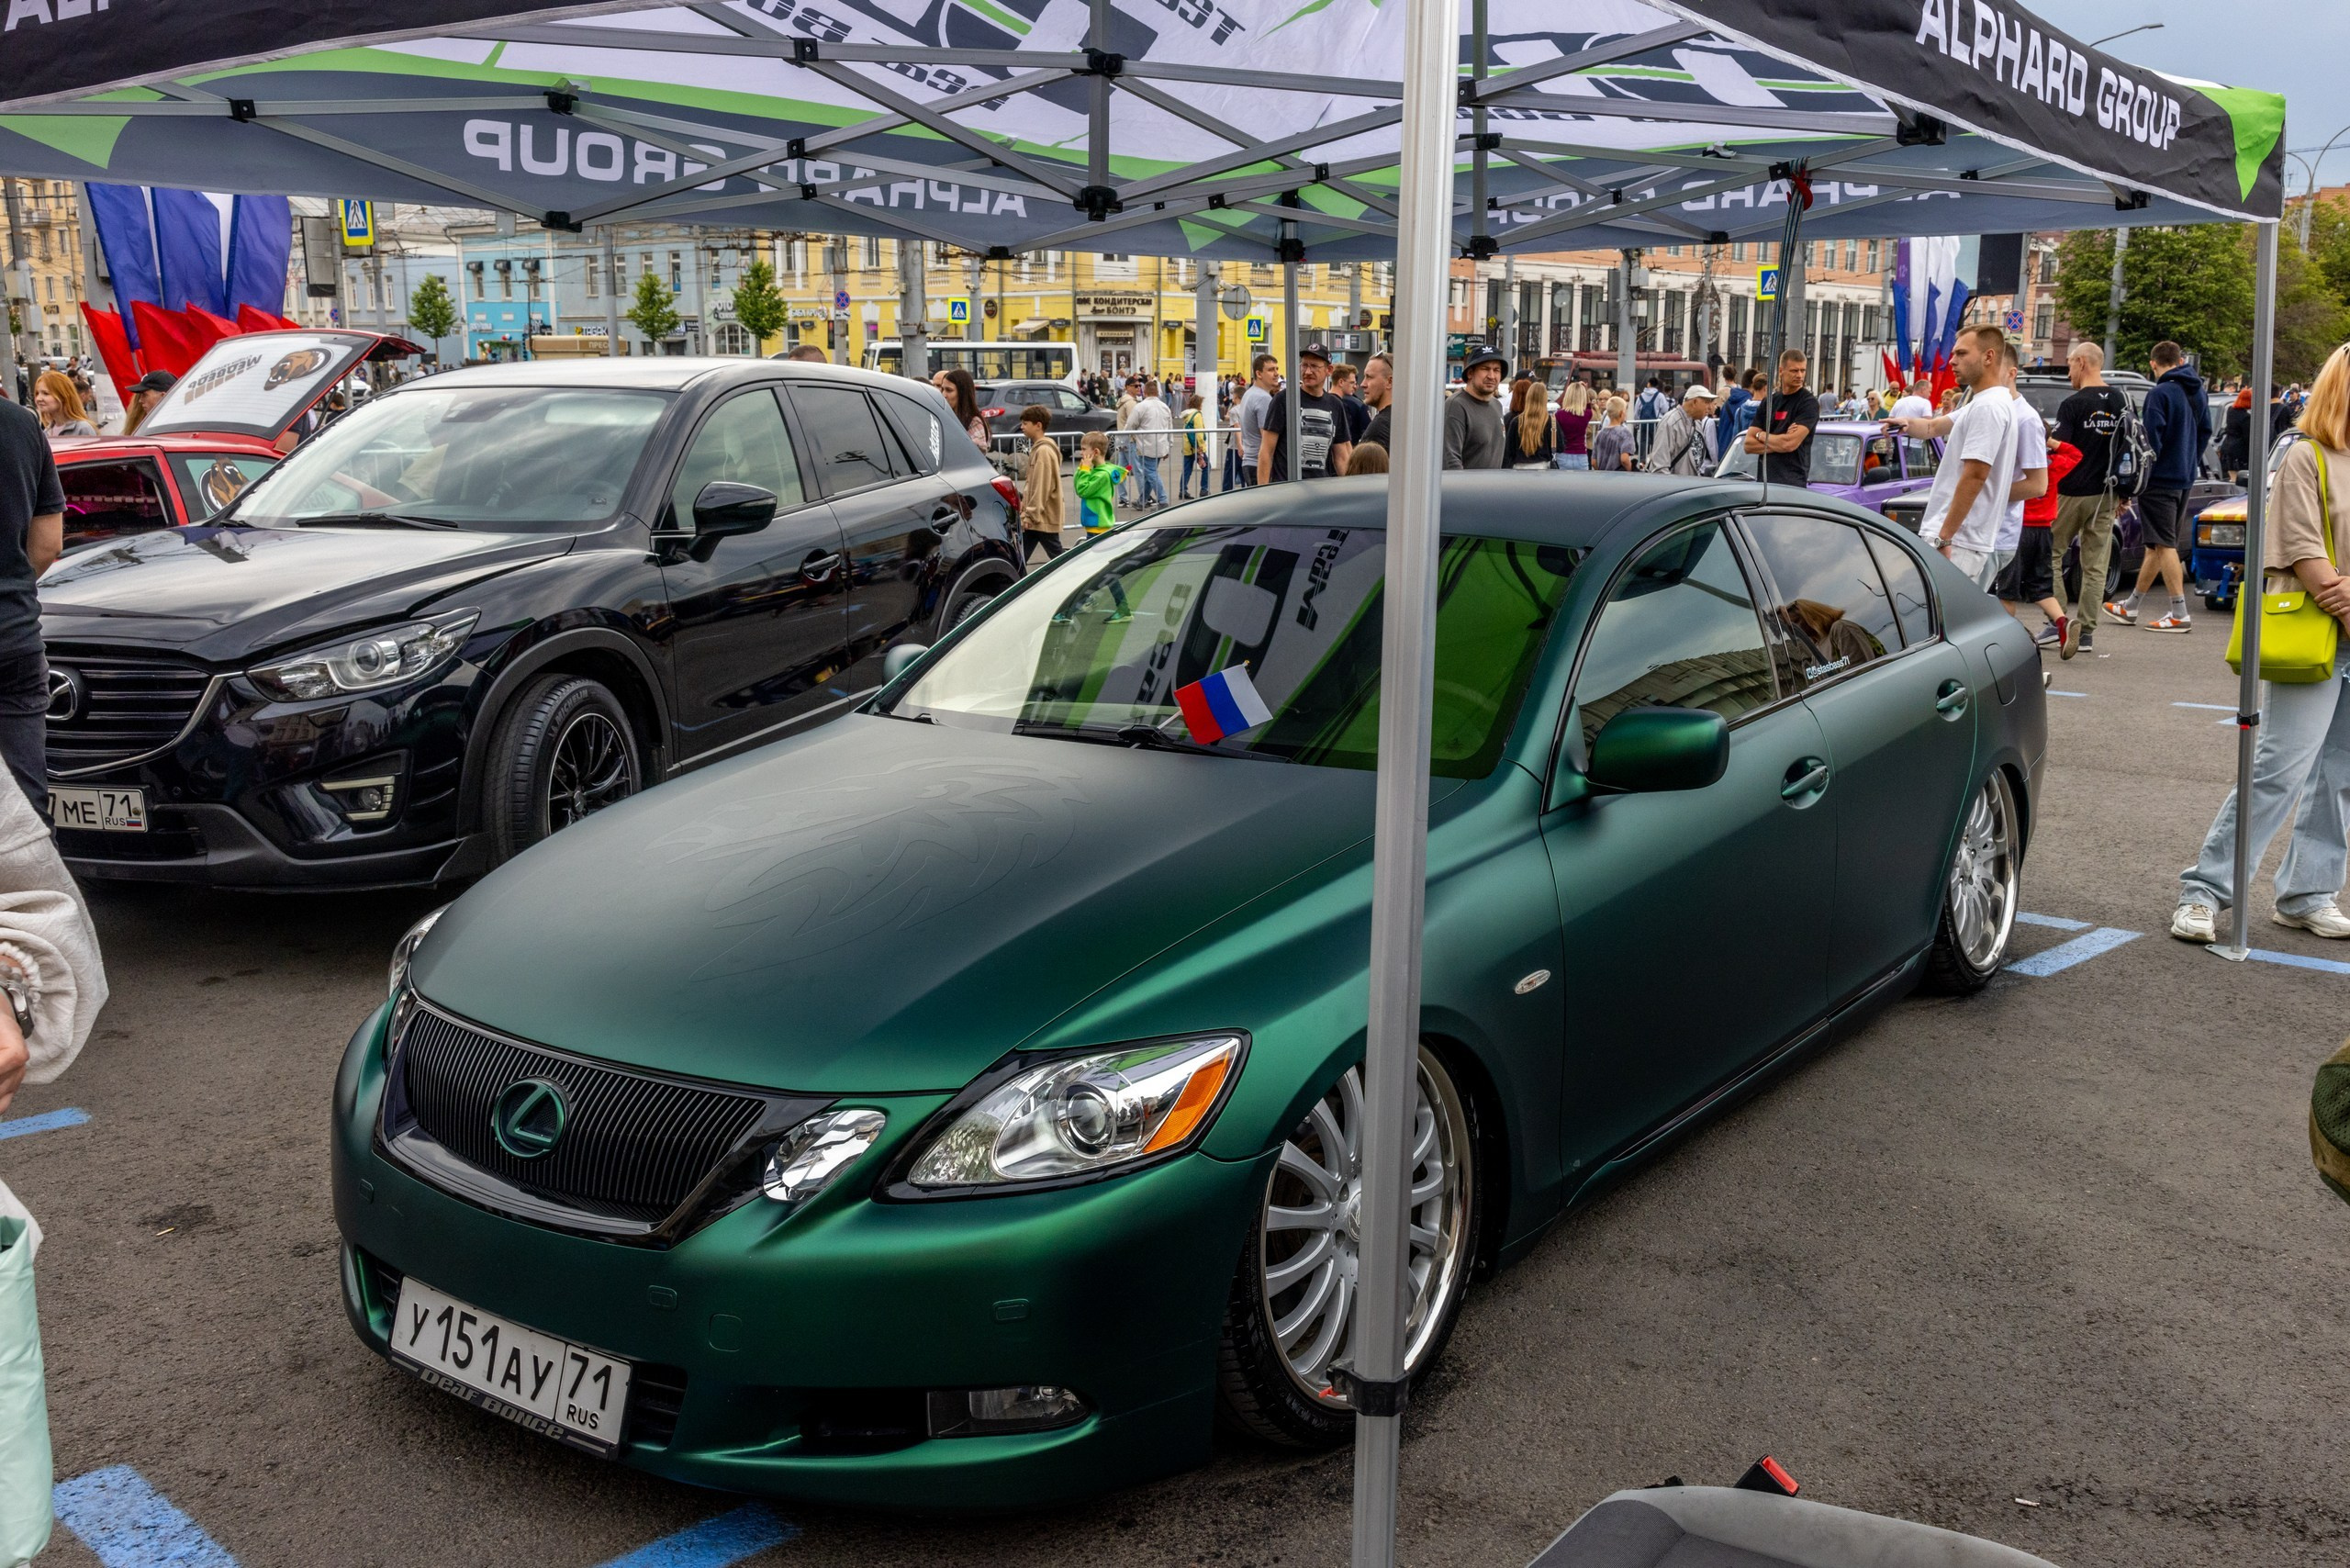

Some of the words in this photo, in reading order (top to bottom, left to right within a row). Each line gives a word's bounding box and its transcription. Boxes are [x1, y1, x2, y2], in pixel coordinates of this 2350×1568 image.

[1915, 0, 2089, 117] ALPHARD
[2097, 67, 2181, 151] GROUP
[588, 341, 610, 349] ПРЕС
[188, 354, 263, 388] МЕДВЕДЬ
[103, 793, 132, 817] 71
[105, 816, 126, 826] RUS
[568, 1351, 613, 1411] 71
[566, 1403, 599, 1430] RUS
